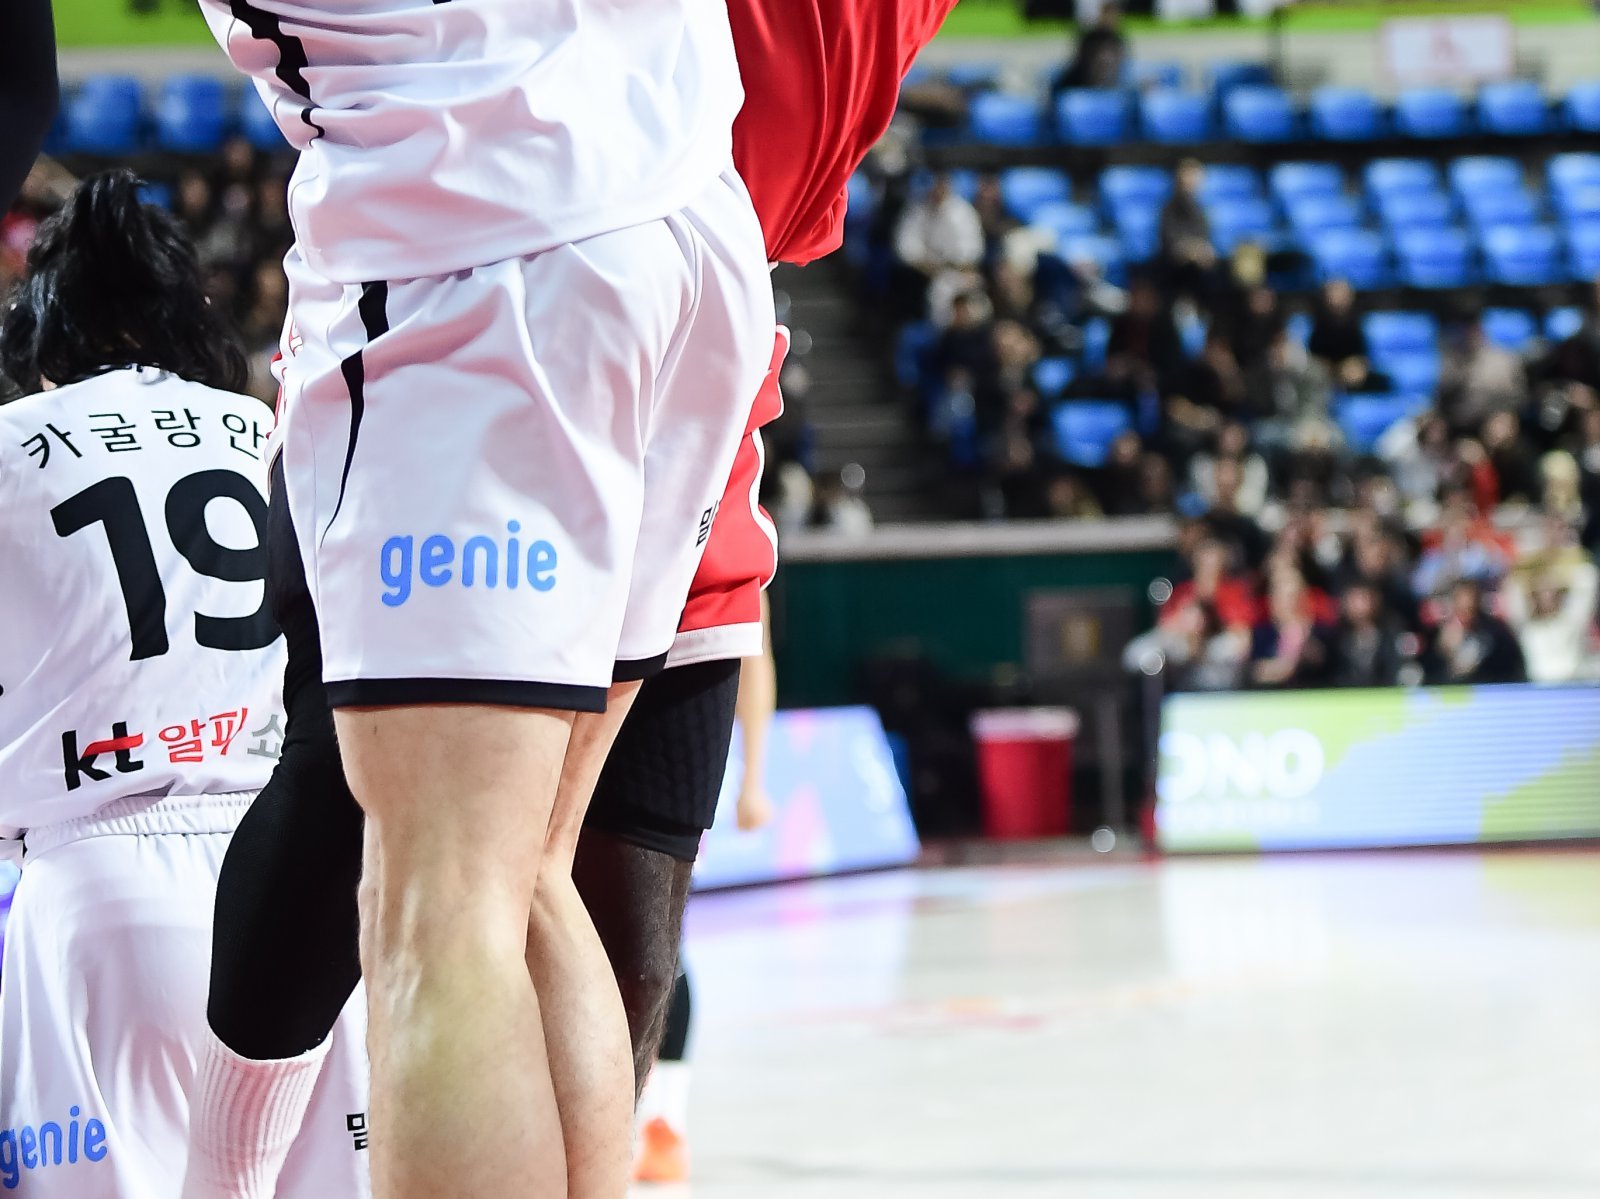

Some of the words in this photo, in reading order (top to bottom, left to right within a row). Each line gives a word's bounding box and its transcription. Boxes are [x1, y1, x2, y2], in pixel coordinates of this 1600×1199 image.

[20, 408, 264, 469] 카굴랑안
[50, 469, 283, 661] 19
[380, 520, 558, 608] genie
[62, 722, 144, 791] kt
[0, 1106, 108, 1190] genie
